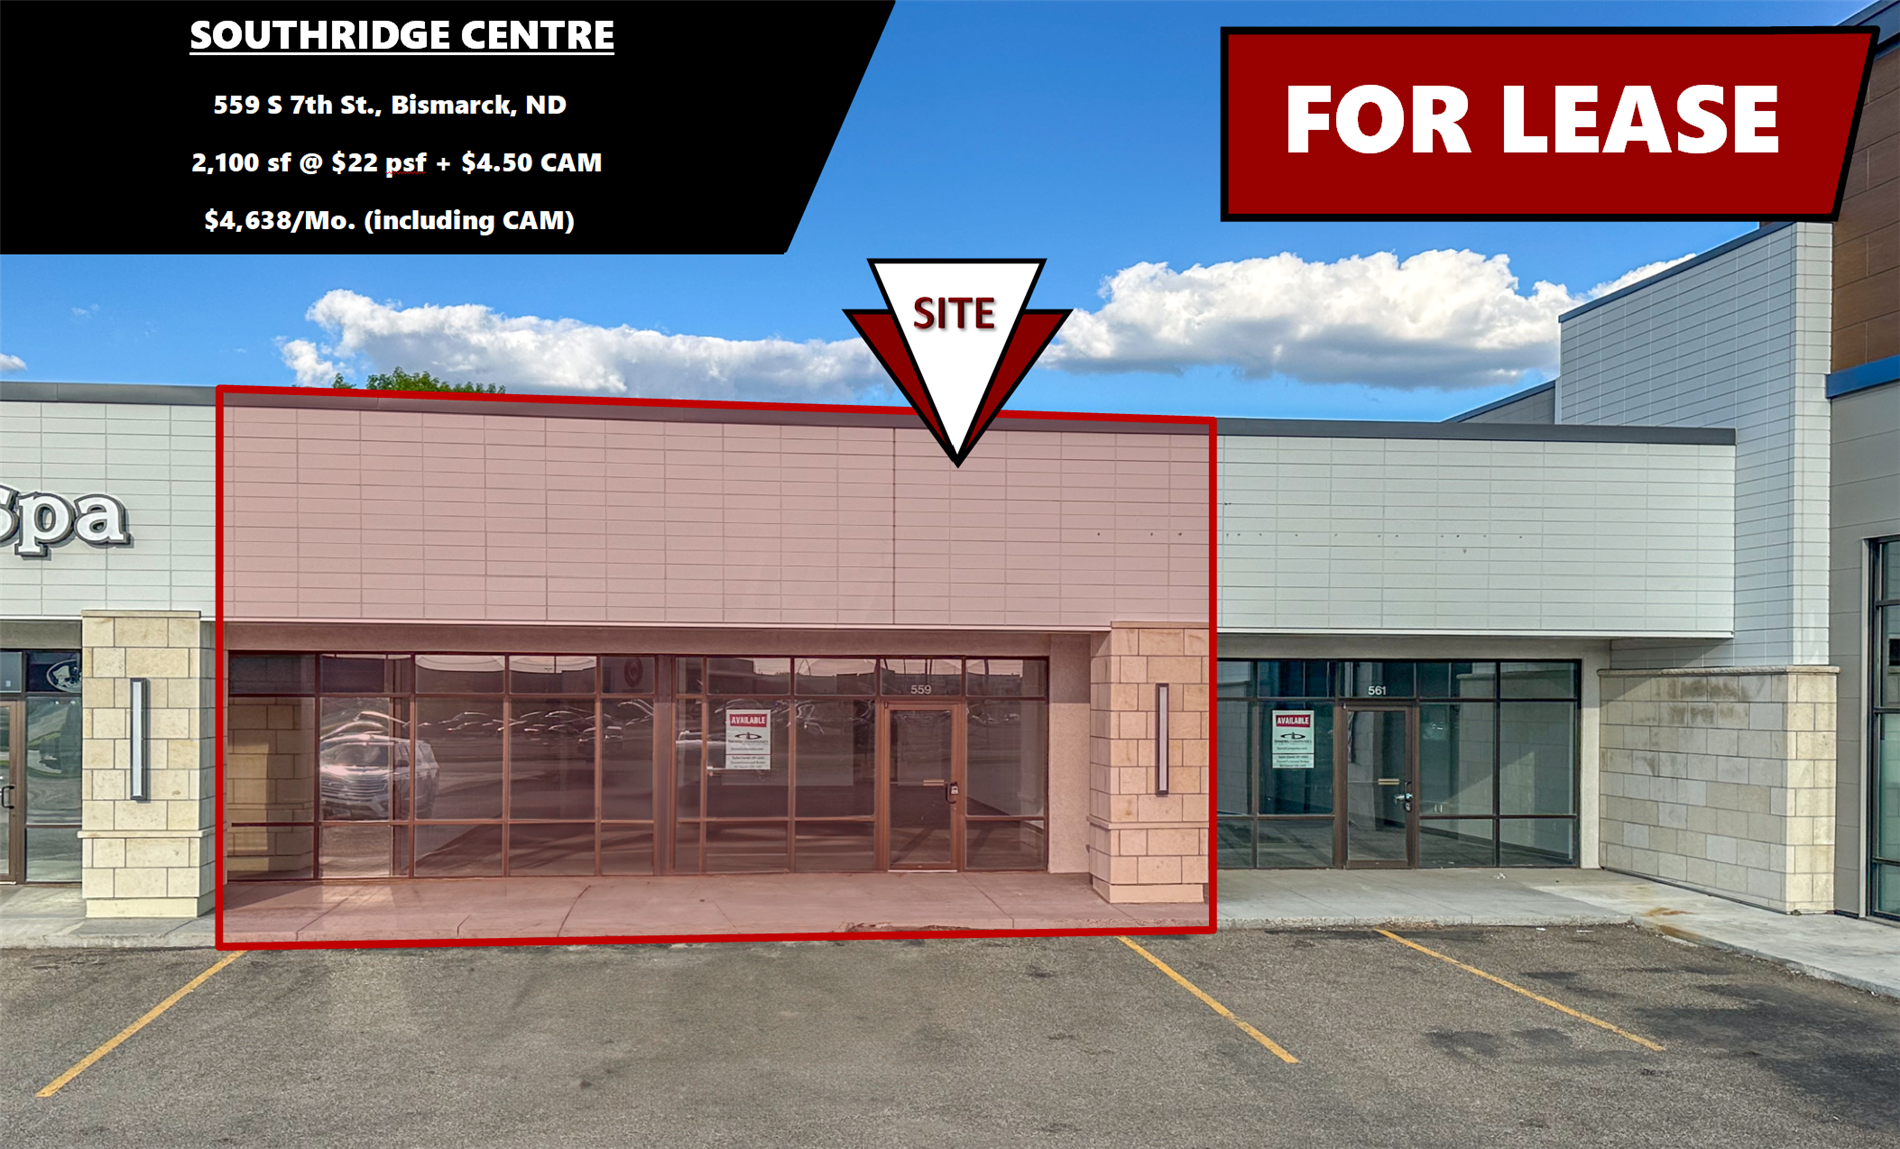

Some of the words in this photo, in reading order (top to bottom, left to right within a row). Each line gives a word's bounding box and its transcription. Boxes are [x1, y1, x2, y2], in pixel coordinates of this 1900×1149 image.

[910, 684, 932, 695] 559
[1368, 685, 1387, 696] 561
[731, 715, 766, 725] AVAILABLE
[1277, 716, 1310, 725] AVAILABLE
